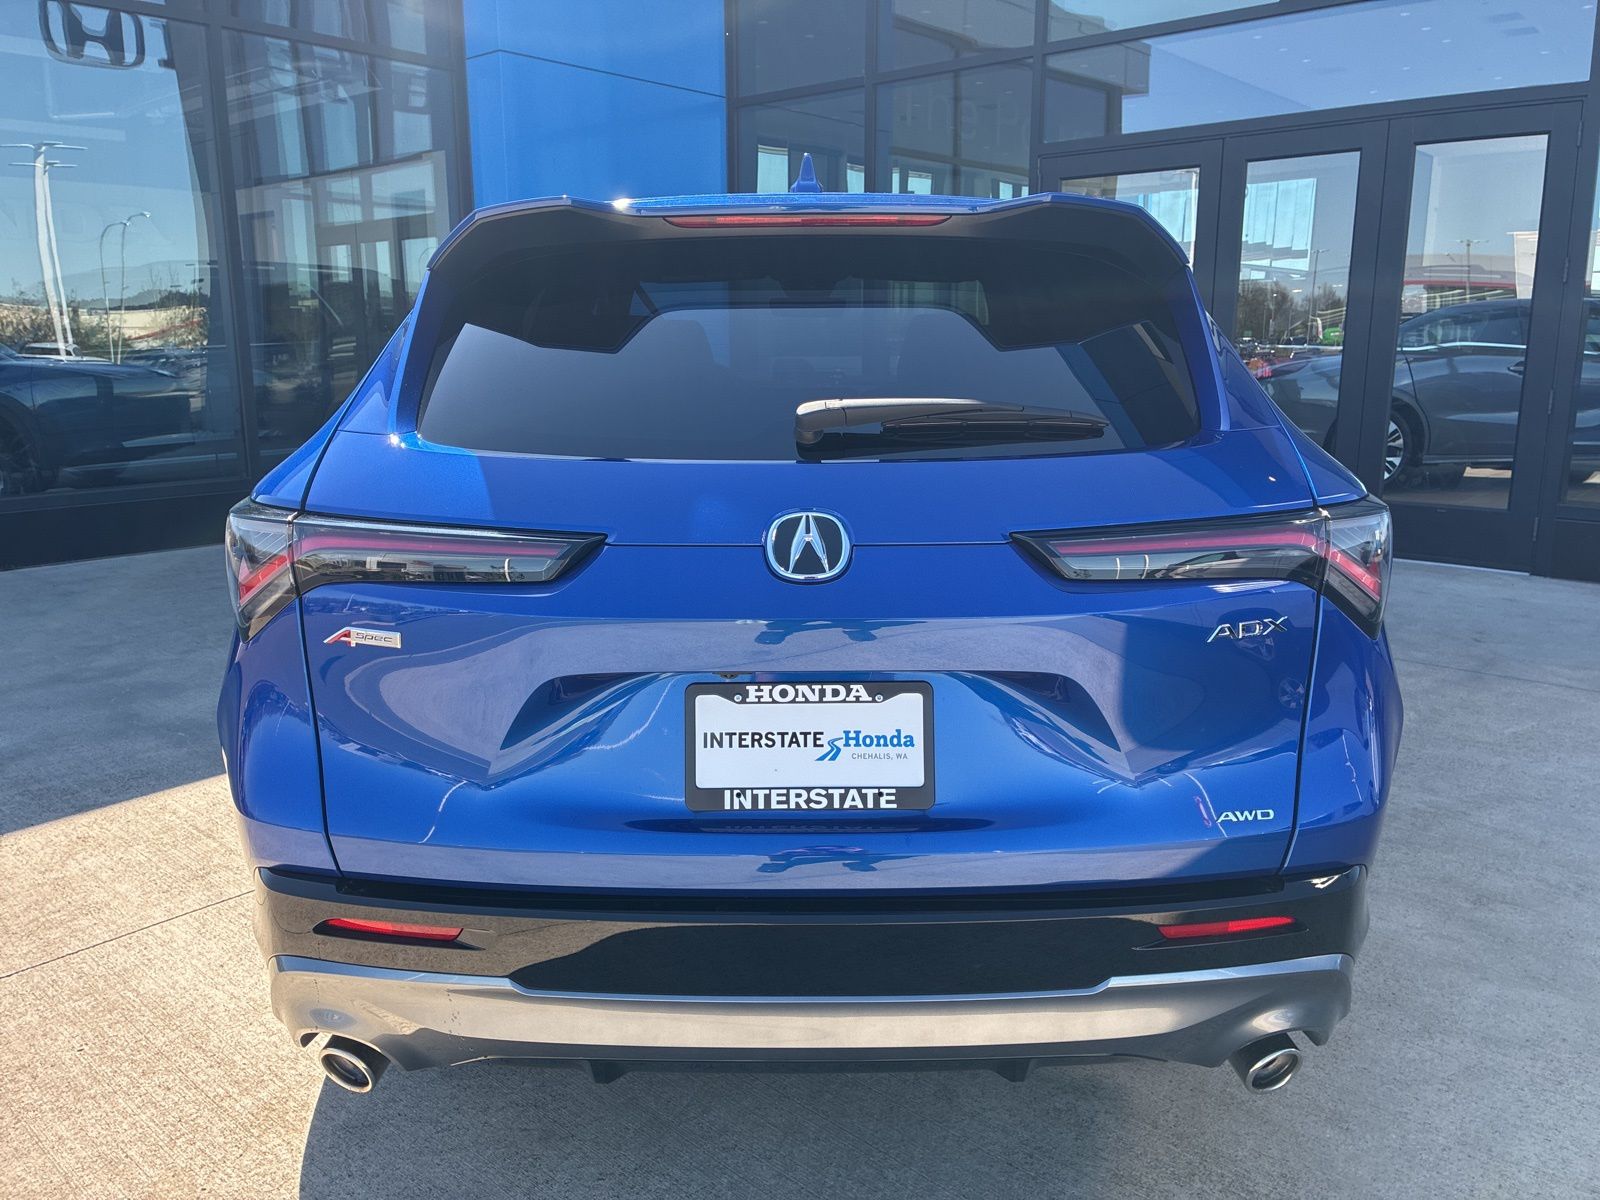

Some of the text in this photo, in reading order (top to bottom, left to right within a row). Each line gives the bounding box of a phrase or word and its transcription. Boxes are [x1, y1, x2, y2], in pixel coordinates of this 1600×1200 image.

[1206, 616, 1288, 643] ADX
[745, 684, 872, 703] HONDA
[703, 729, 915, 749] INTERSTATE Honda
[852, 753, 893, 761] CHEHALIS,
[724, 788, 897, 810] INTERSTATE
[1217, 809, 1274, 823] AWD
